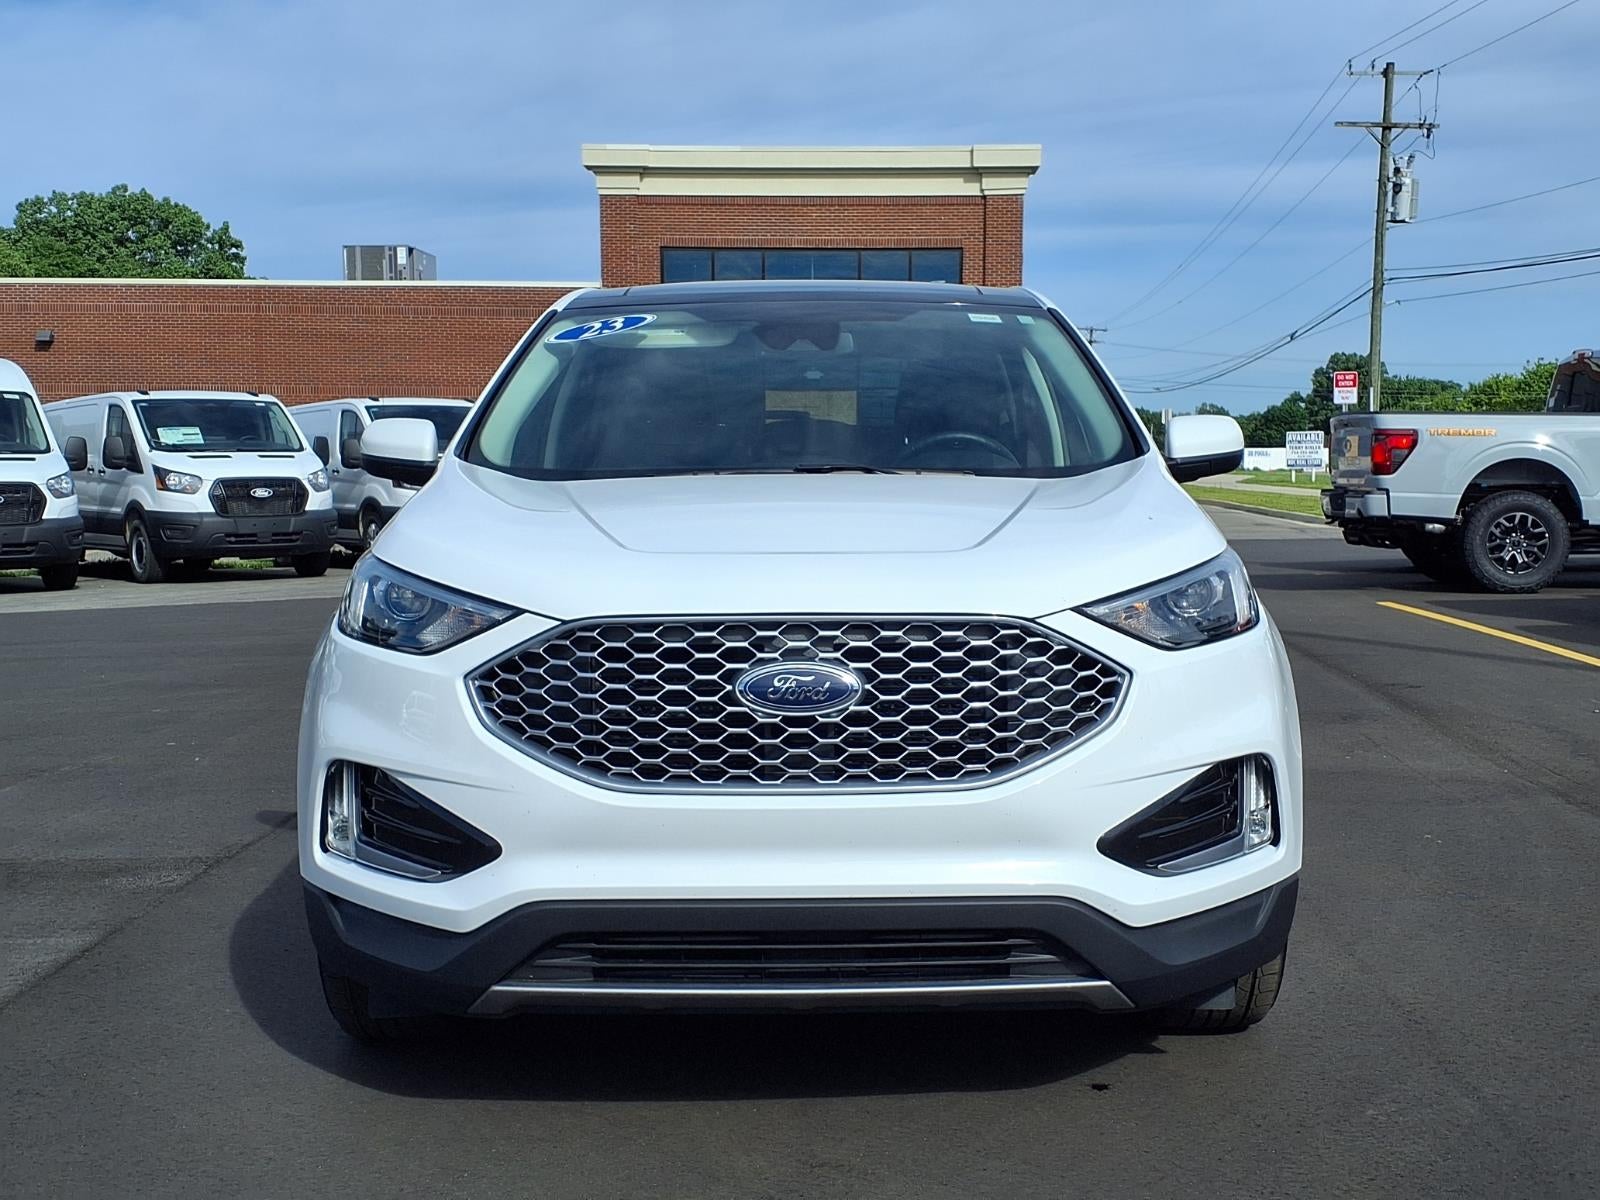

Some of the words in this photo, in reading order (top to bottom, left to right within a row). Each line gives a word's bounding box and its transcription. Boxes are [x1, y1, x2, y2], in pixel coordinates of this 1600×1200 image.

[580, 317, 625, 338] 23
[1426, 427, 1496, 437] TREMOR
[767, 674, 831, 700] Ford
